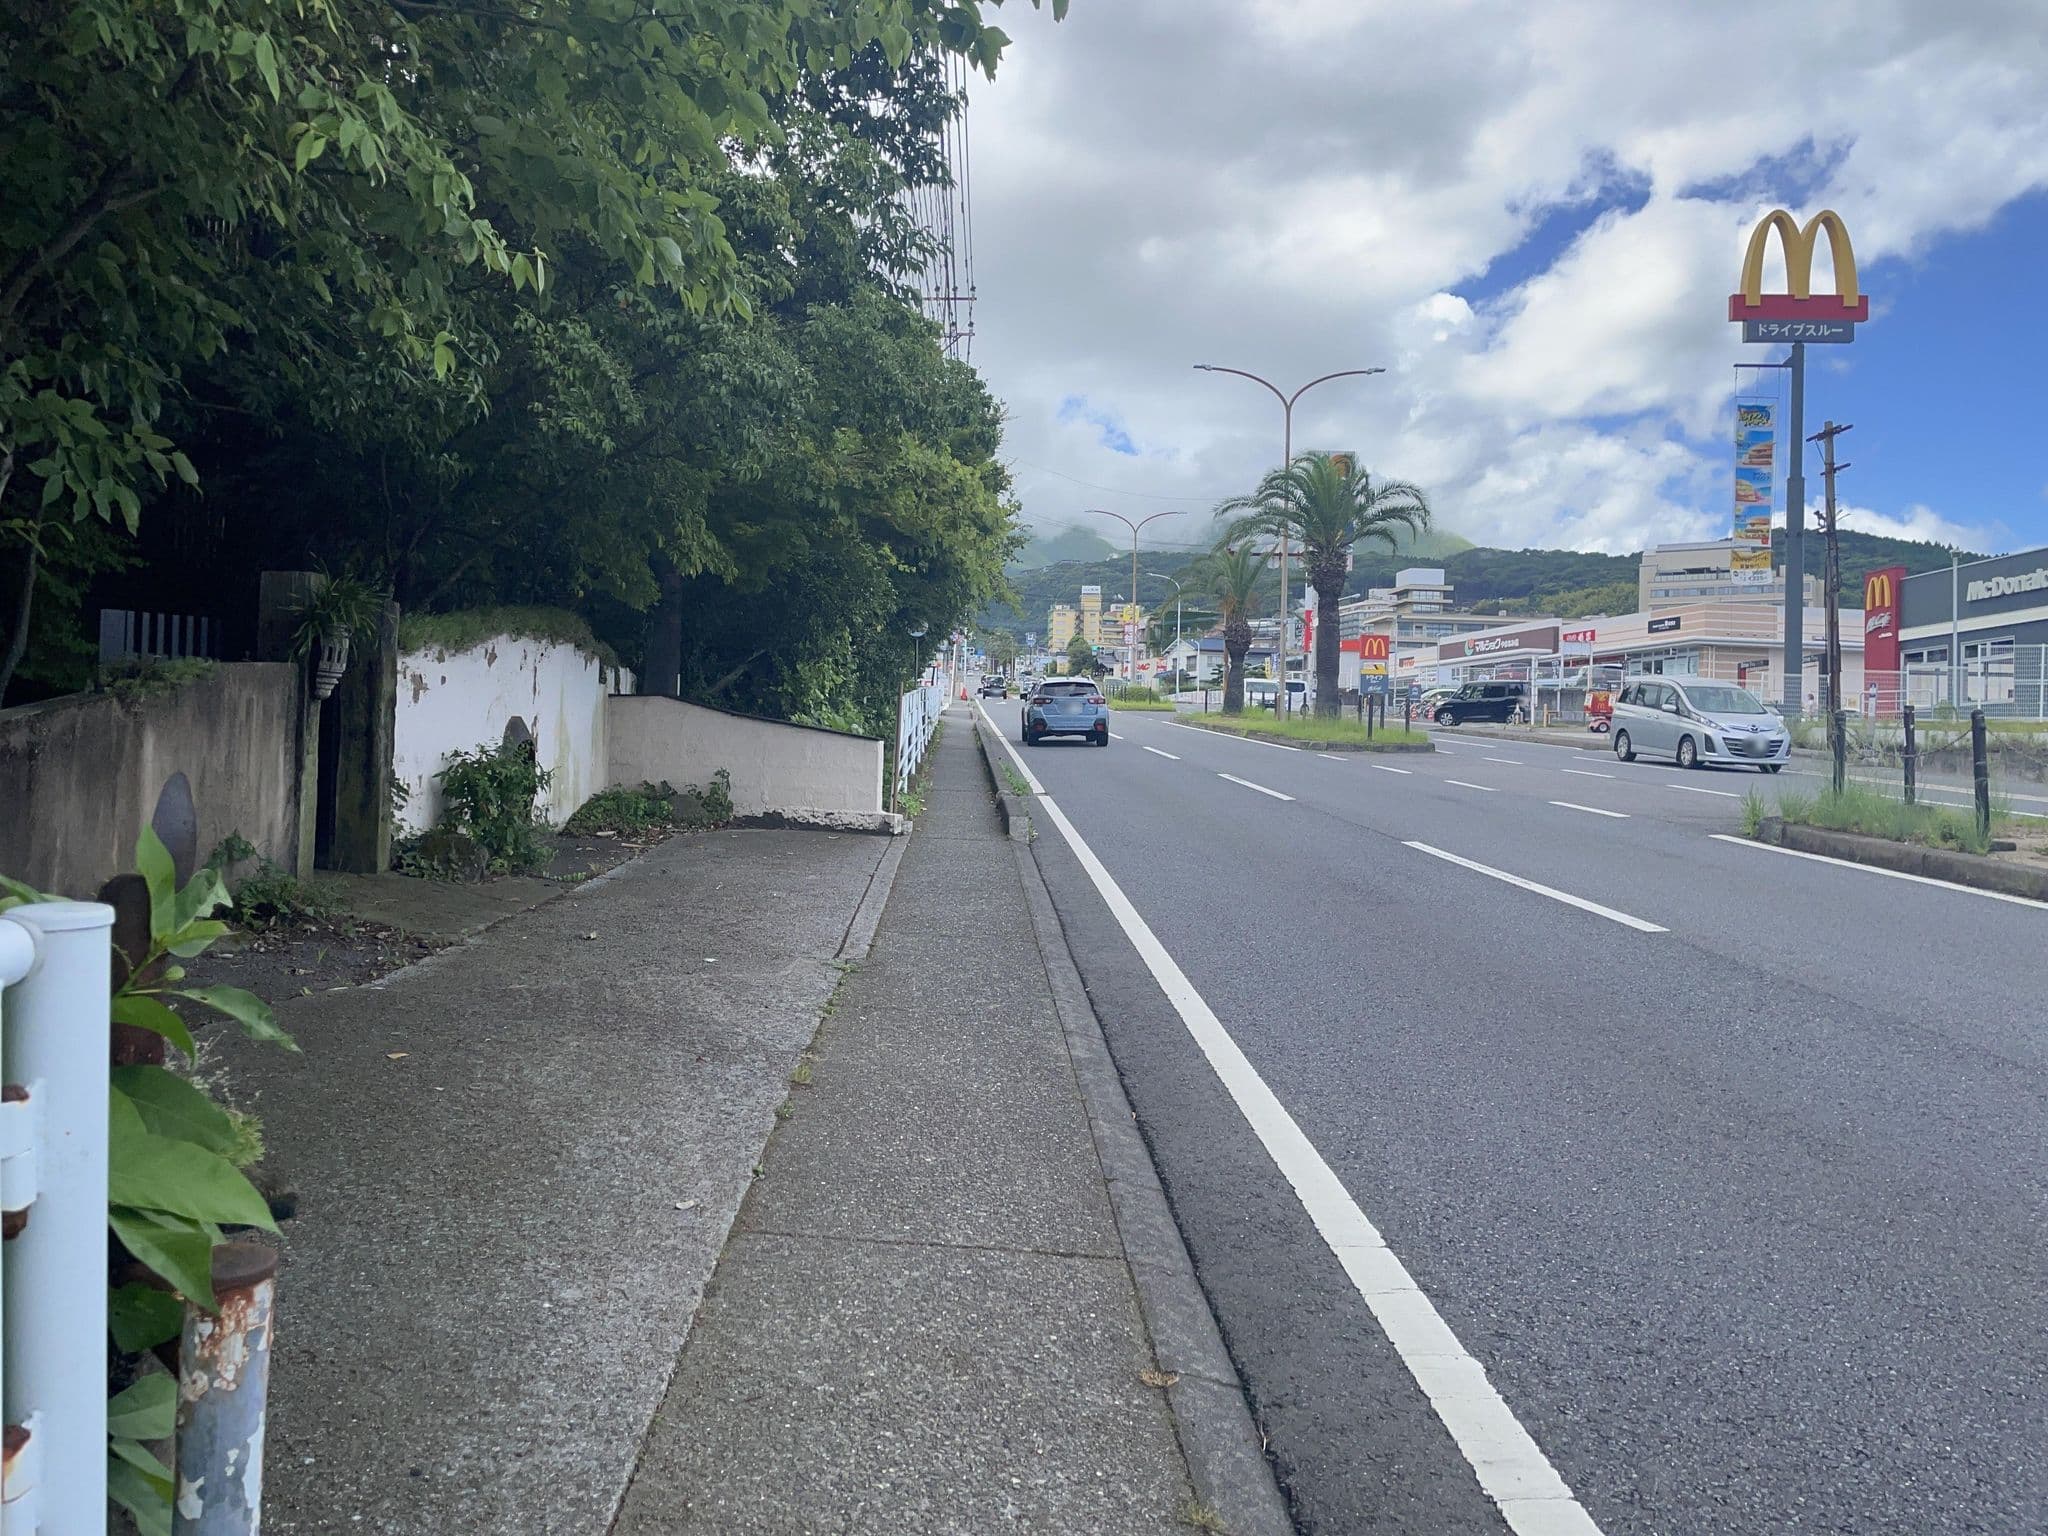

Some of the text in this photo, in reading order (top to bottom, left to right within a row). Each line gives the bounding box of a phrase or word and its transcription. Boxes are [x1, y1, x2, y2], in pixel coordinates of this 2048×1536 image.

[1758, 323, 1844, 337] ドライブスルー
[1474, 638, 1502, 653] マルショク
